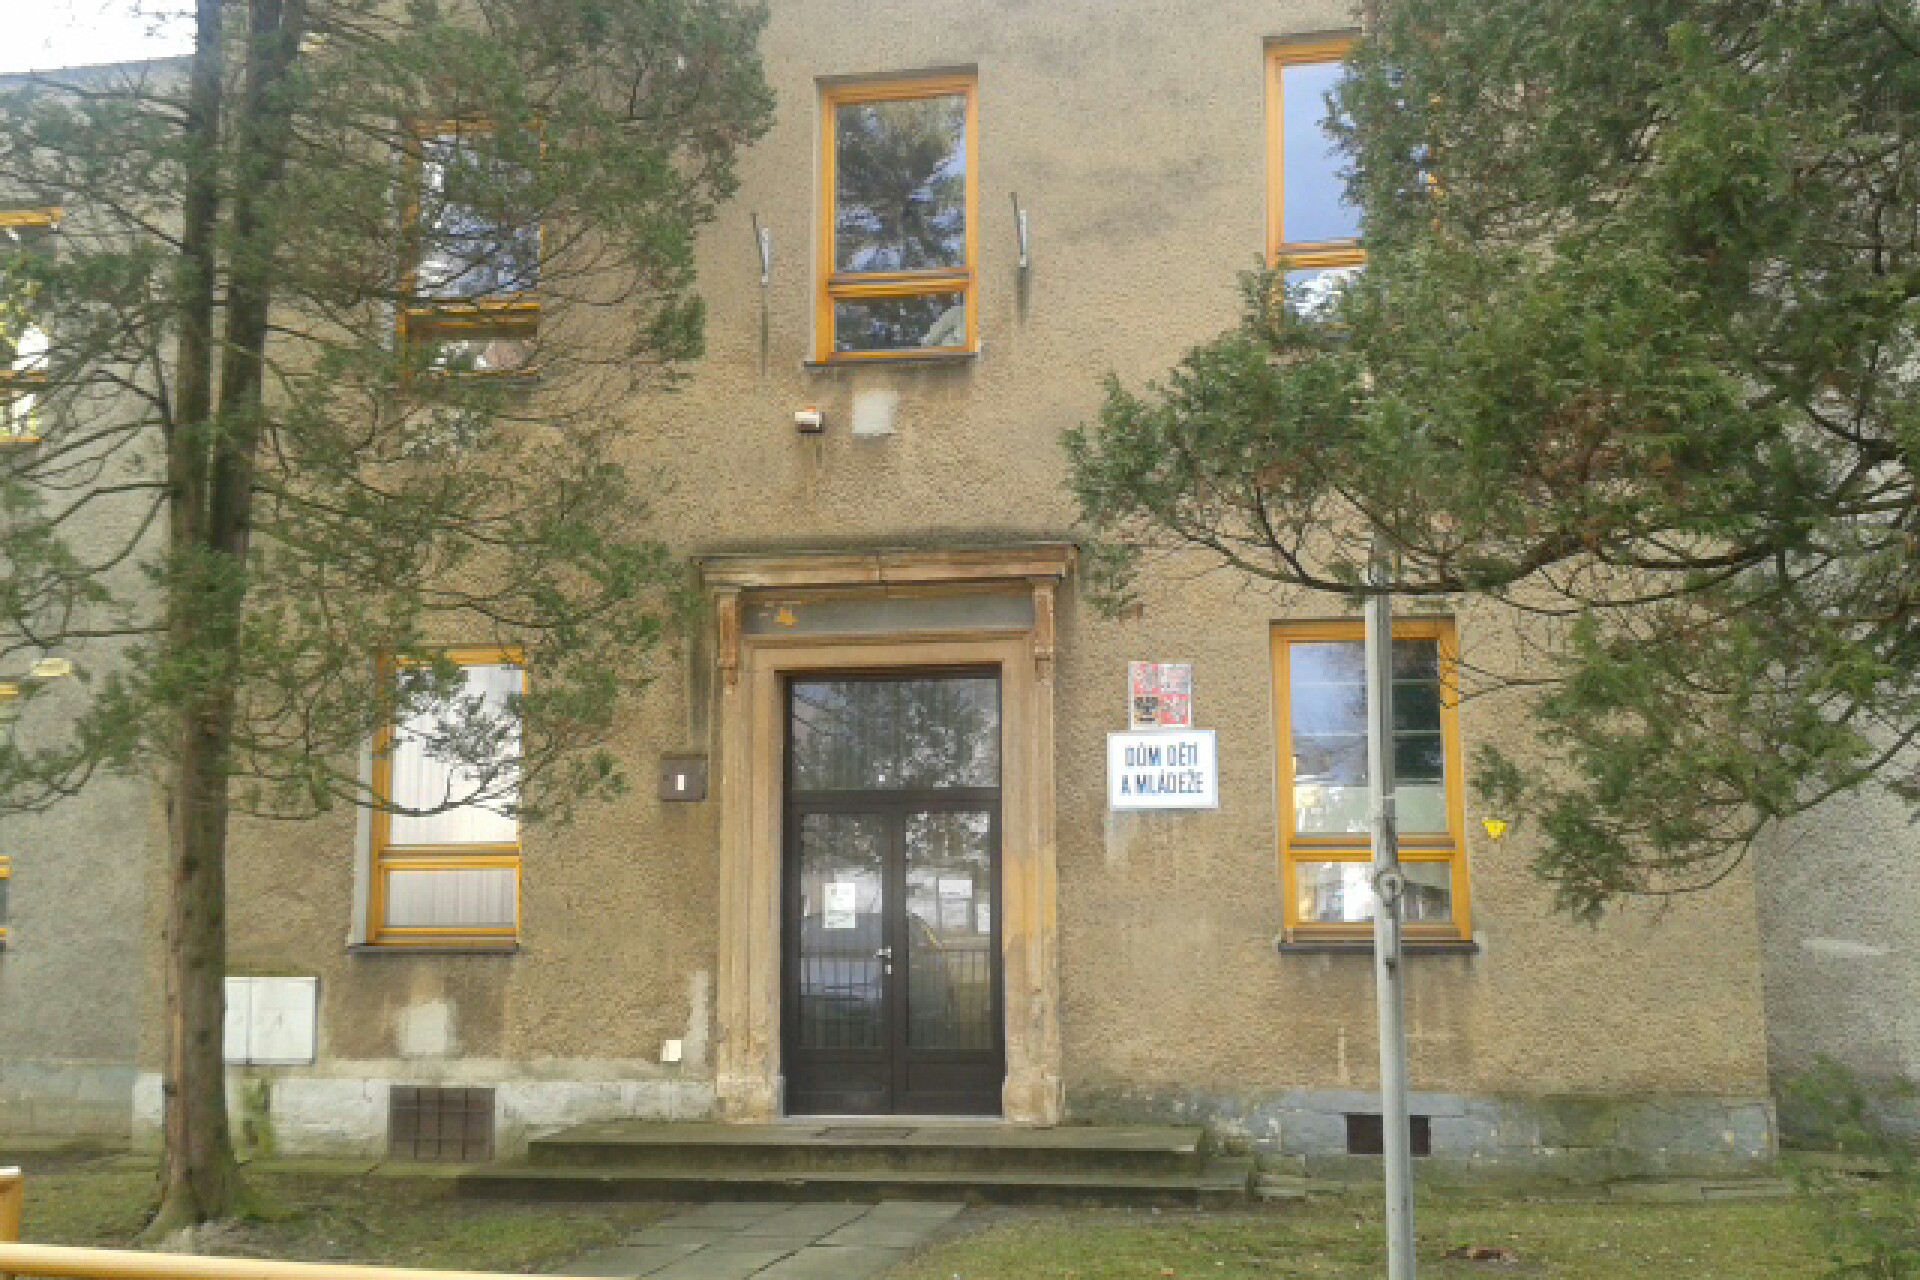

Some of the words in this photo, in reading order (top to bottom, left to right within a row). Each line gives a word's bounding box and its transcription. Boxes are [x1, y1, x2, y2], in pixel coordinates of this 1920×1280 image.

[1124, 742, 1162, 767] DŮM
[1166, 742, 1198, 767] DĚTÍ
[1121, 774, 1132, 795] A
[1135, 769, 1204, 795] MLÁDEŽE
